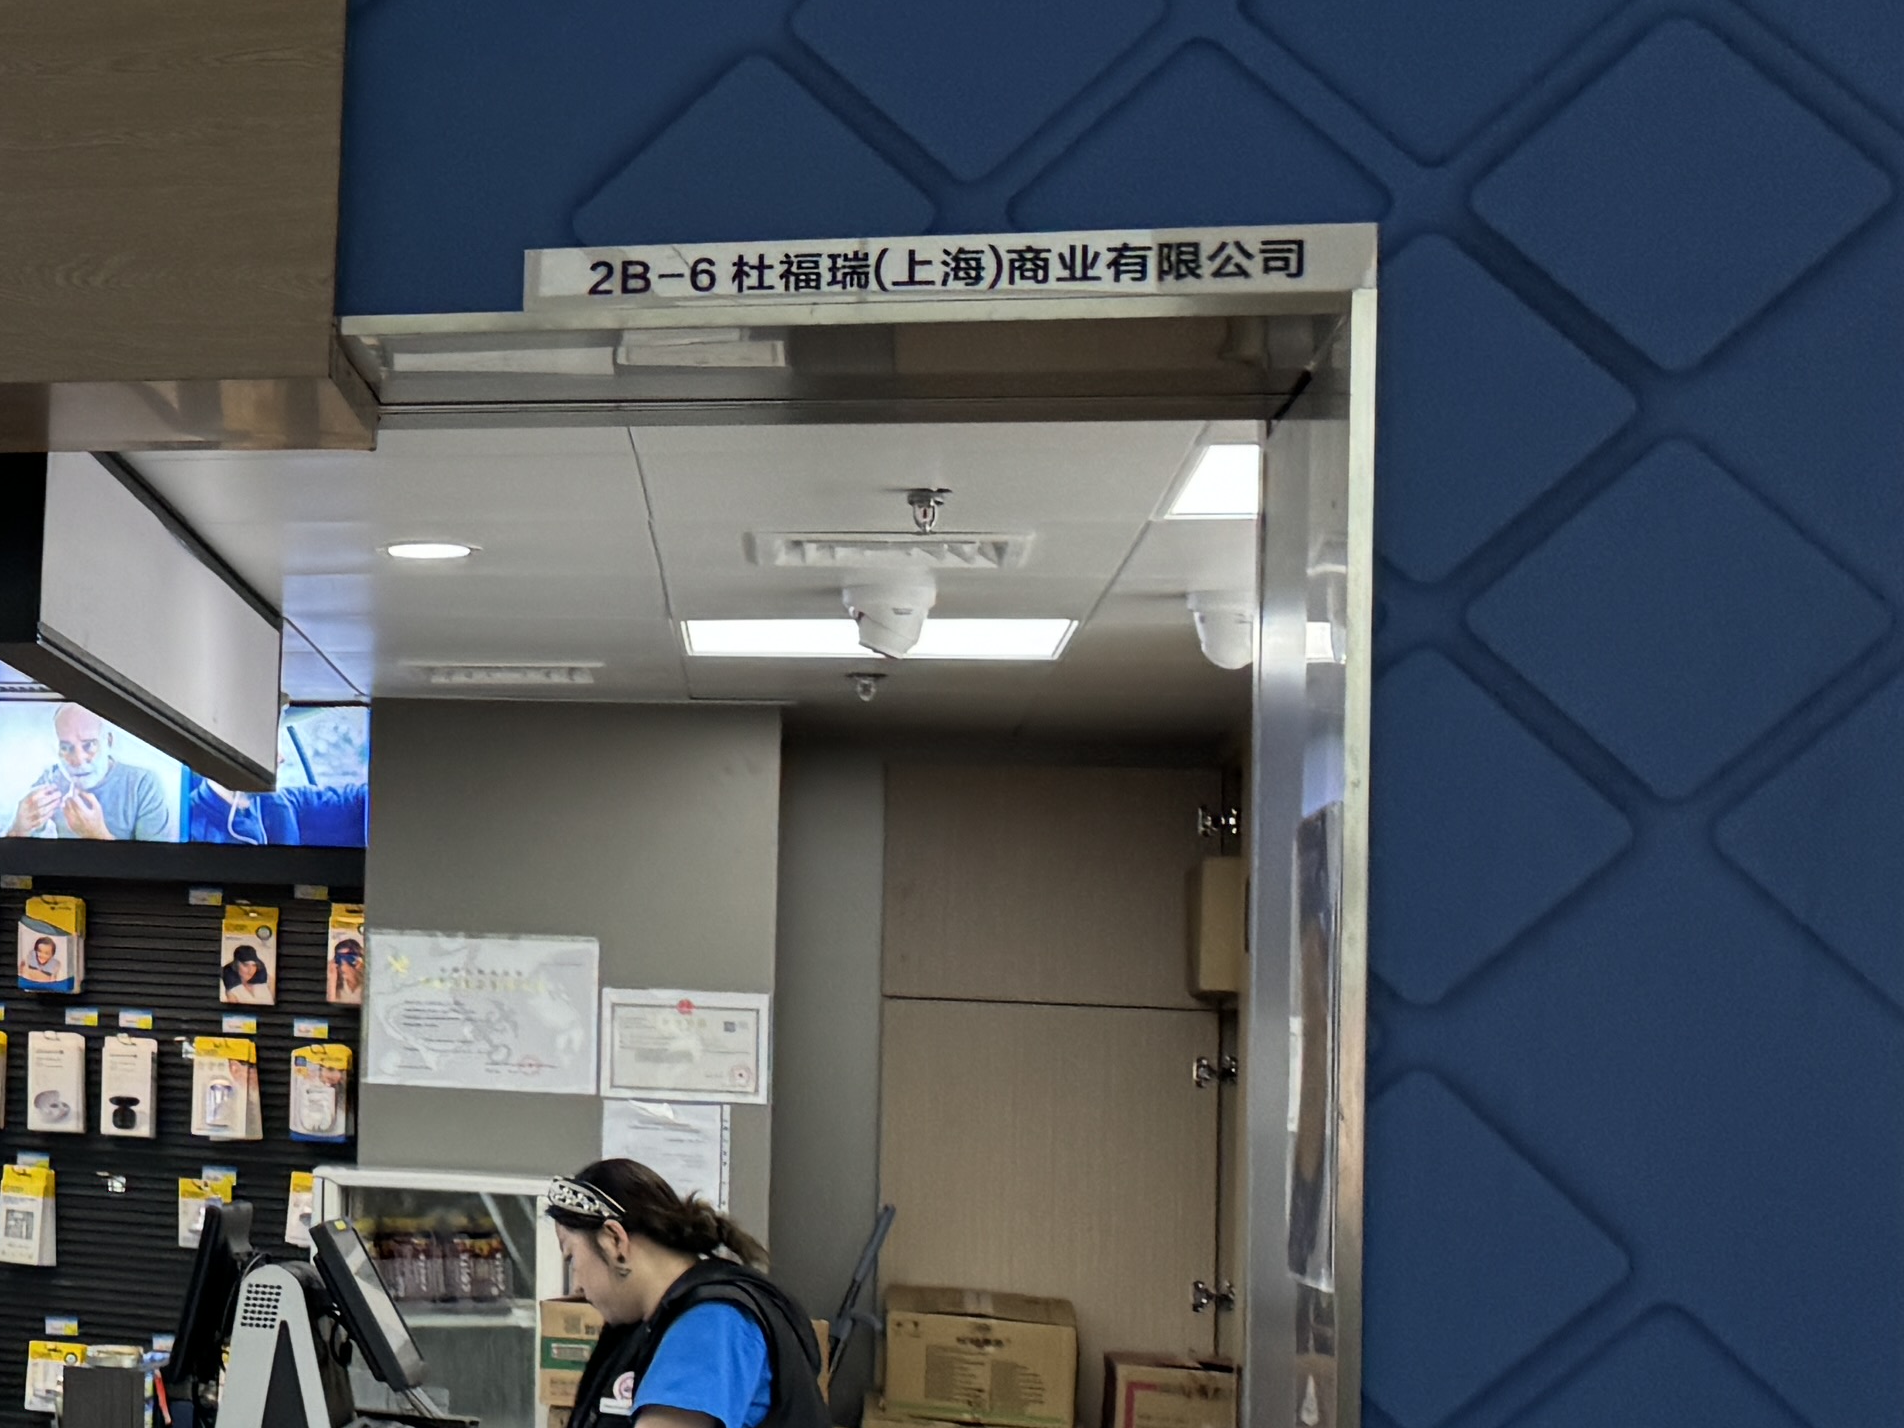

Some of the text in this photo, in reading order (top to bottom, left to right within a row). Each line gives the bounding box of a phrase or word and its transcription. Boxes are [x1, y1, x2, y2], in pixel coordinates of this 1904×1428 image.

[588, 237, 1306, 295] 2B-6 杜福瑞(上海)商业有限公司
